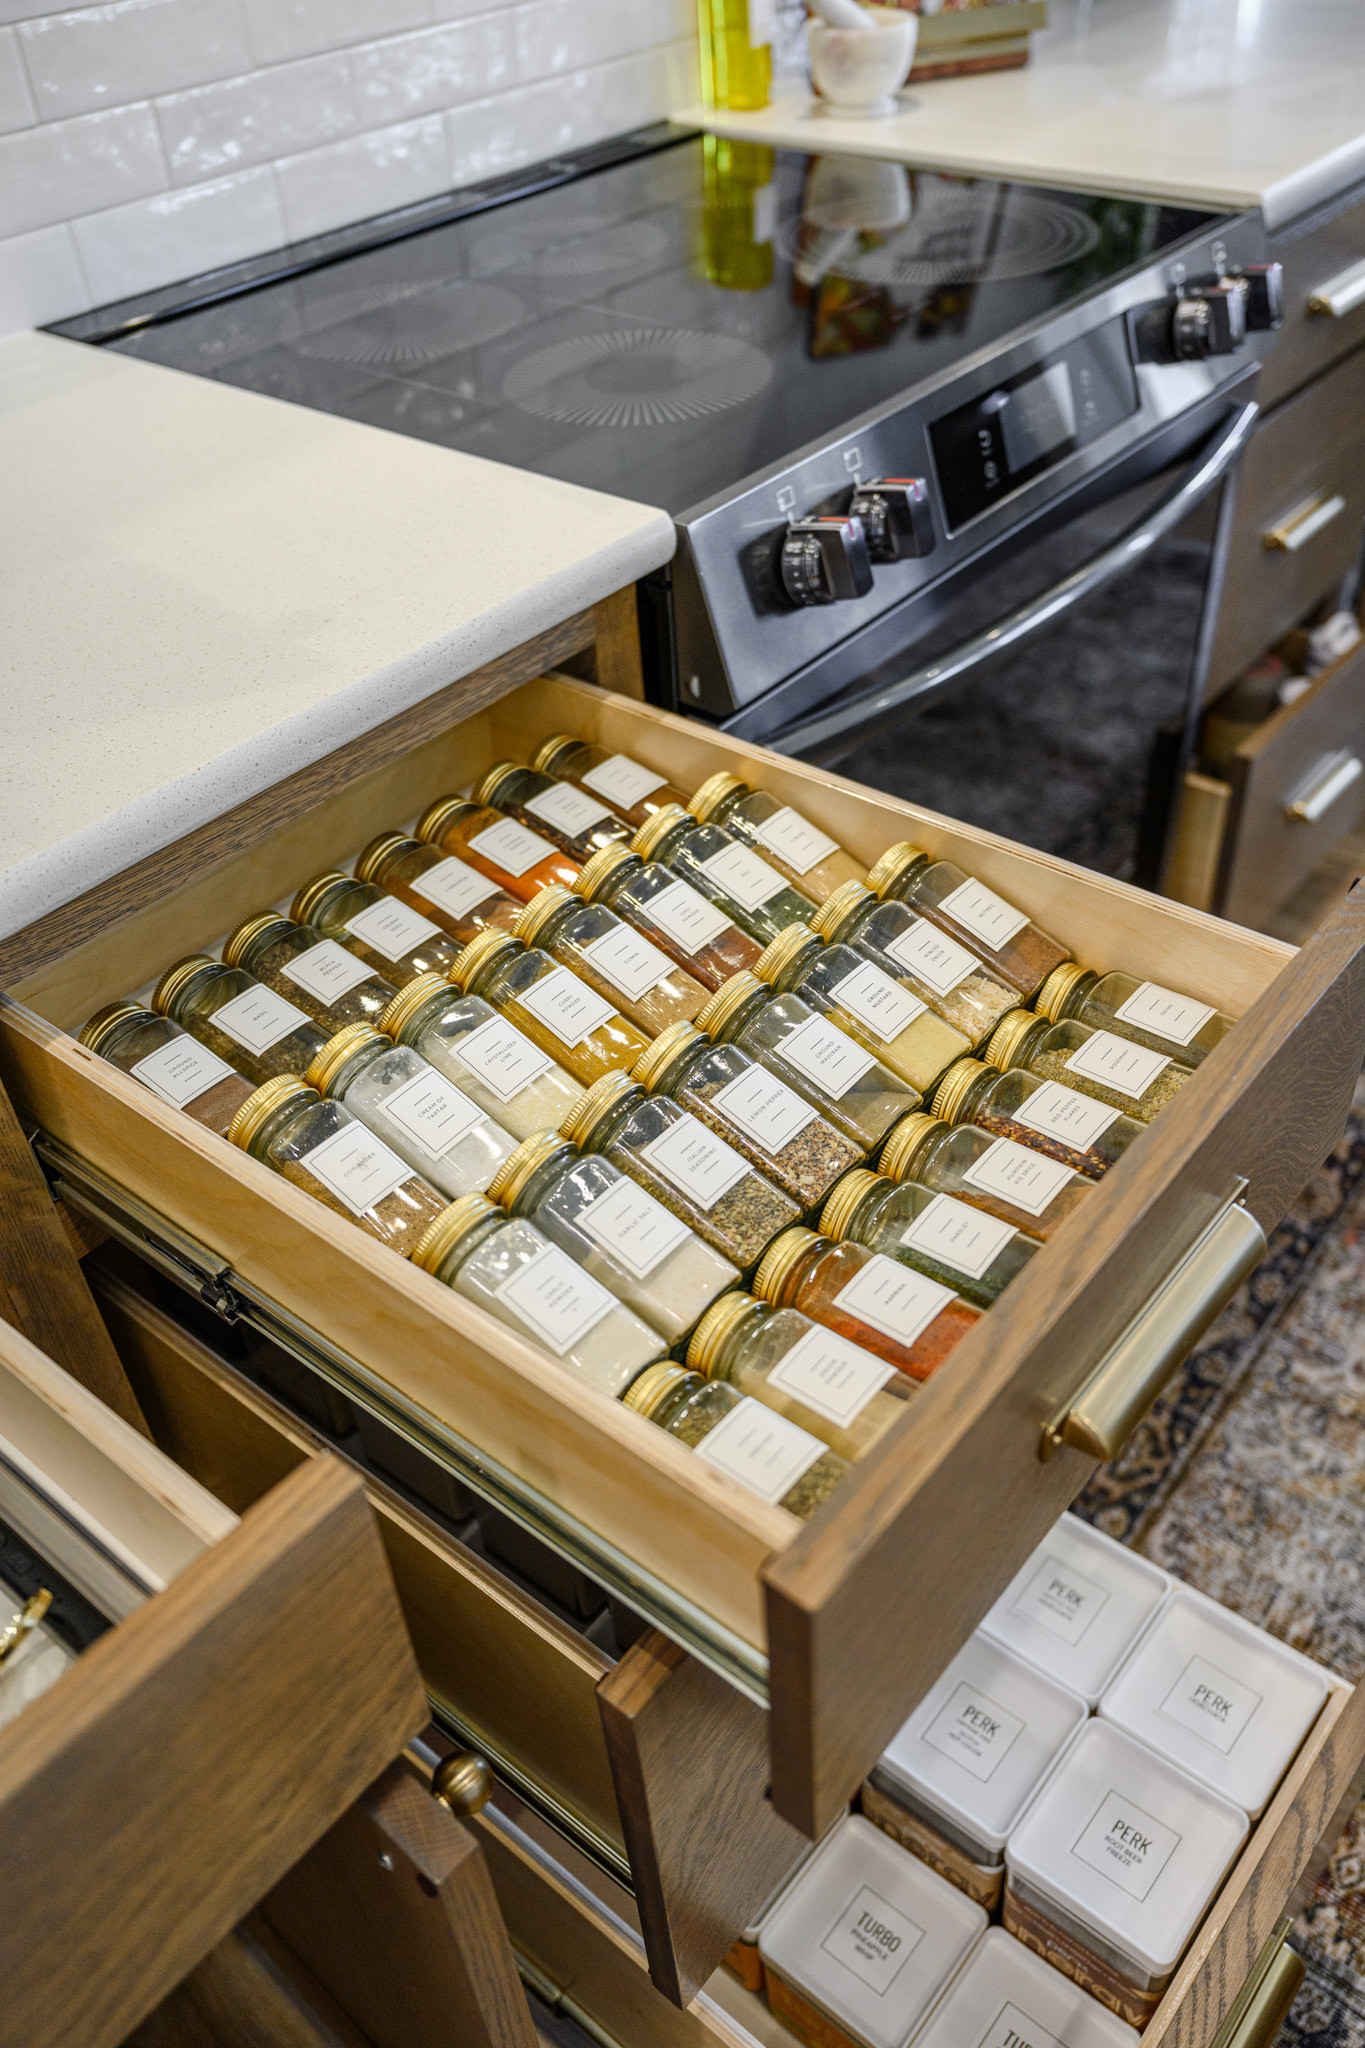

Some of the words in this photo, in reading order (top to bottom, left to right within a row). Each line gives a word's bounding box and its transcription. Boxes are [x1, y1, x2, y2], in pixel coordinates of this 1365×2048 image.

[682, 909, 699, 923] POWDER
[978, 904, 995, 918] NUTMEG
[624, 952, 639, 964] CUMIN
[924, 944, 939, 959] MINCED
[931, 950, 945, 962] ONION
[319, 960, 335, 972] BLACK
[323, 963, 342, 976] PEPPER
[558, 994, 573, 1007] CURRY
[867, 986, 885, 1003] GROUND
[872, 991, 892, 1009] MUSTARD
[561, 997, 580, 1013] POWDER
[1161, 1004, 1173, 1016] THYME
[253, 1010, 268, 1021] BASIL
[485, 1040, 517, 1066] CRYSTALLIZED
[500, 1052, 512, 1063] LIME
[815, 1040, 834, 1059] GROUND
[169, 1056, 193, 1074] GROUND
[1109, 1049, 1130, 1070] ROSEMARY
[173, 1060, 198, 1078] ALLSPICE
[418, 1102, 436, 1118] CREAM
[436, 1095, 444, 1104] OF
[427, 1104, 447, 1121] TARTAR
[748, 1104, 767, 1123] LEMON
[766, 1089, 784, 1106] PEPPER
[1051, 1111, 1063, 1123] RED
[1060, 1097, 1077, 1115] PEPPER
[1063, 1105, 1080, 1121] FLAKES
[687, 1145, 706, 1162] ITALIAN
[689, 1147, 717, 1172] SEASONING
[344, 1152, 376, 1178] CORIANDER
[1006, 1158, 1027, 1181] PUMPKIN
[1014, 1173, 1025, 1185] PIE
[1022, 1162, 1036, 1177] SPICE
[618, 1219, 639, 1238] GARLIC
[638, 1207, 652, 1221] SALT
[1048, 1578, 1087, 1609] PERK
[1194, 1683, 1234, 1717] PERK
[962, 1704, 1001, 1738] PERK
[1111, 1819, 1153, 1855] PERK
[1104, 1835, 1124, 1851] ROOT
[1123, 1848, 1143, 1865] BEER
[1105, 1846, 1132, 1867] FREEZE
[858, 1910, 902, 1953] TURBO
